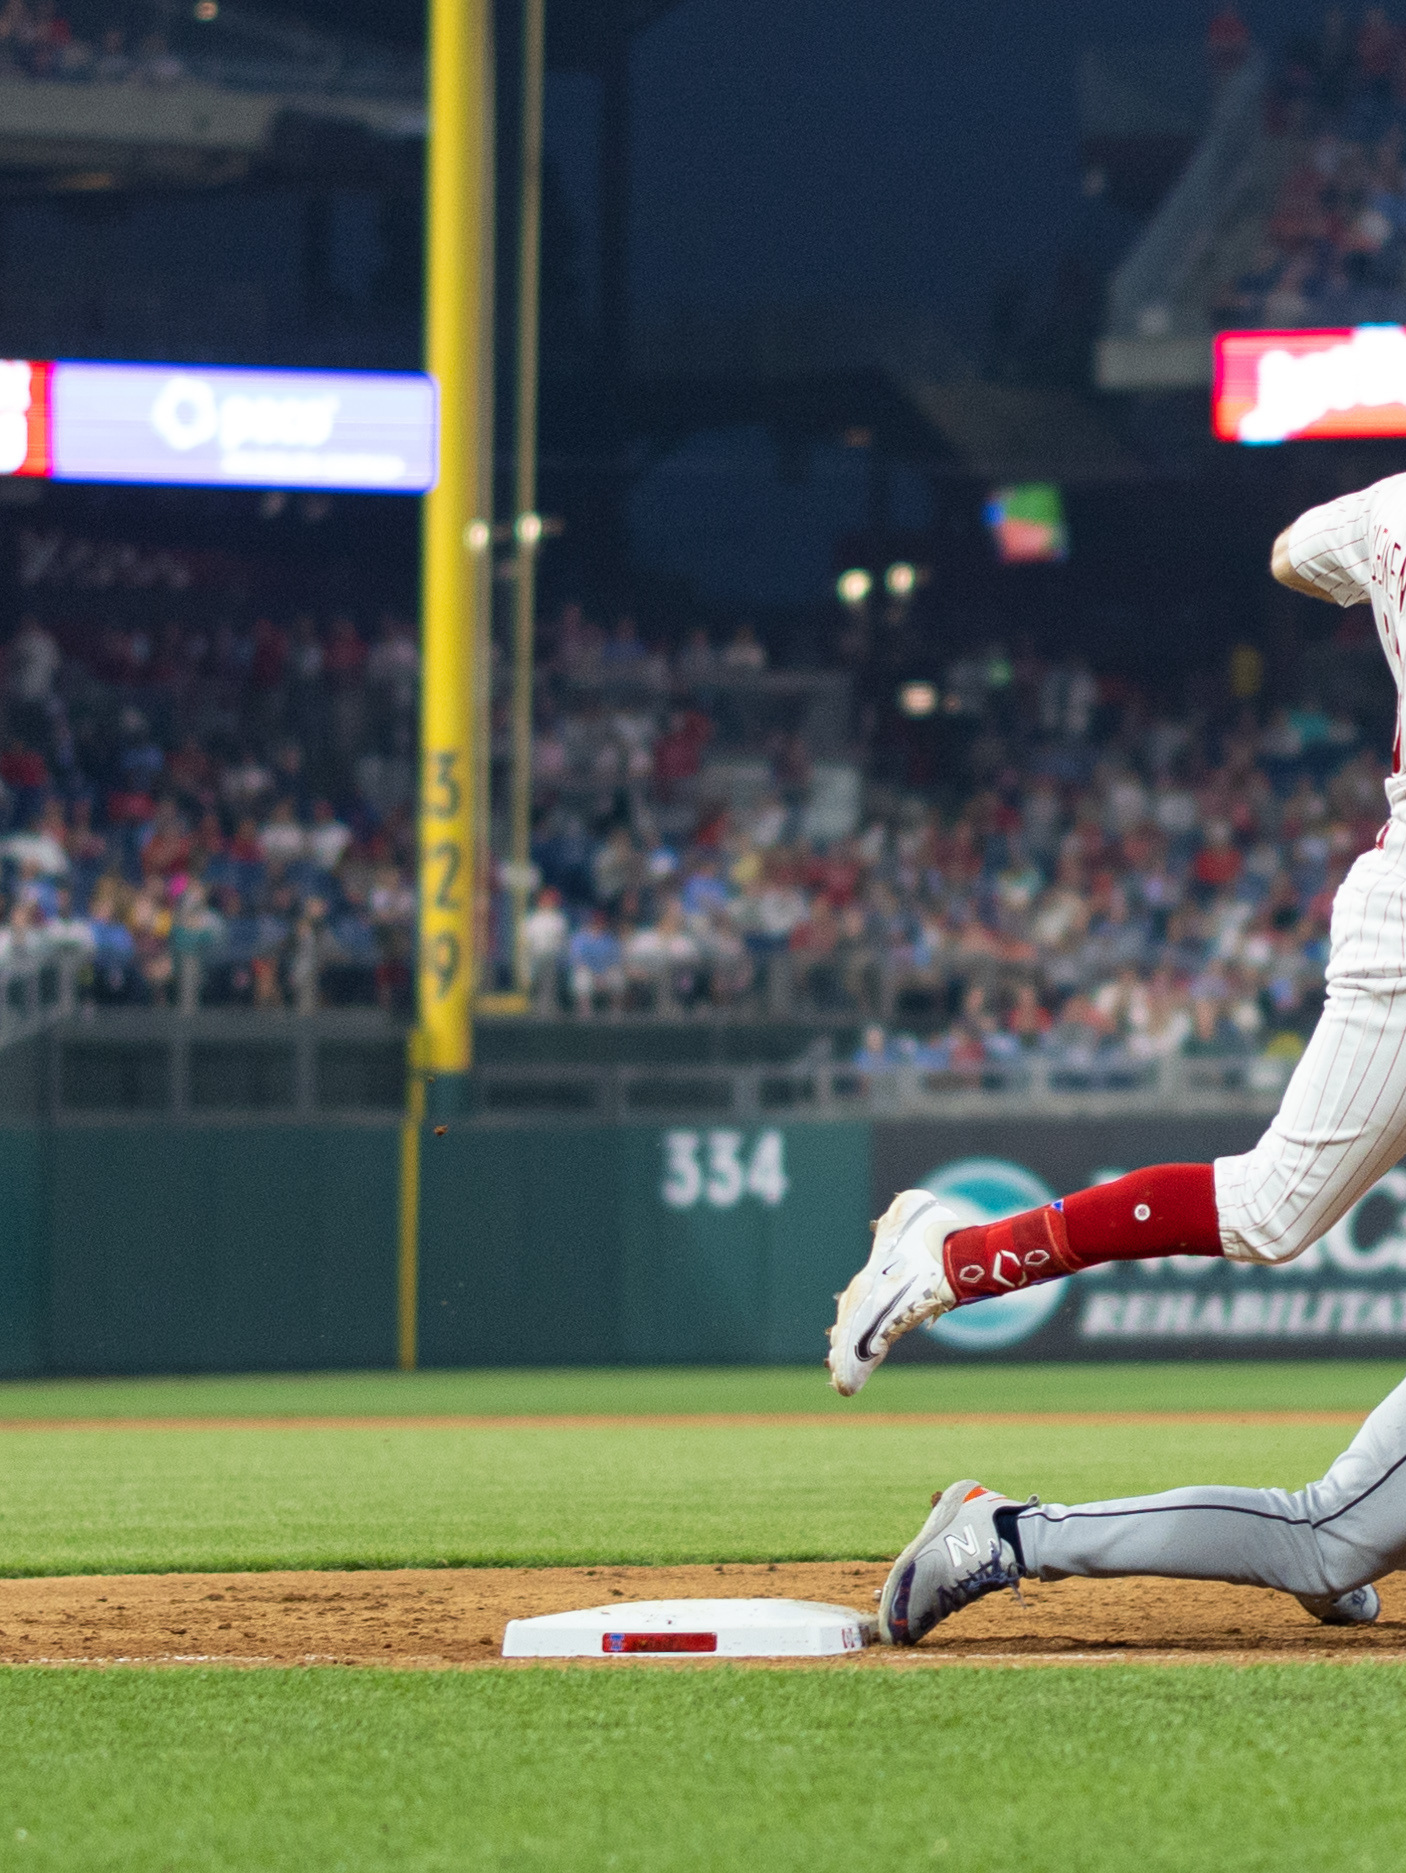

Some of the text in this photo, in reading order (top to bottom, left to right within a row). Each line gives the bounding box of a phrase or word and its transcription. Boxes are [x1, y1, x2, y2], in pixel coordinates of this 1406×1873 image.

[428, 751, 463, 1000] 329
[663, 1129, 788, 1206] 334
[943, 1522, 980, 1568] N
